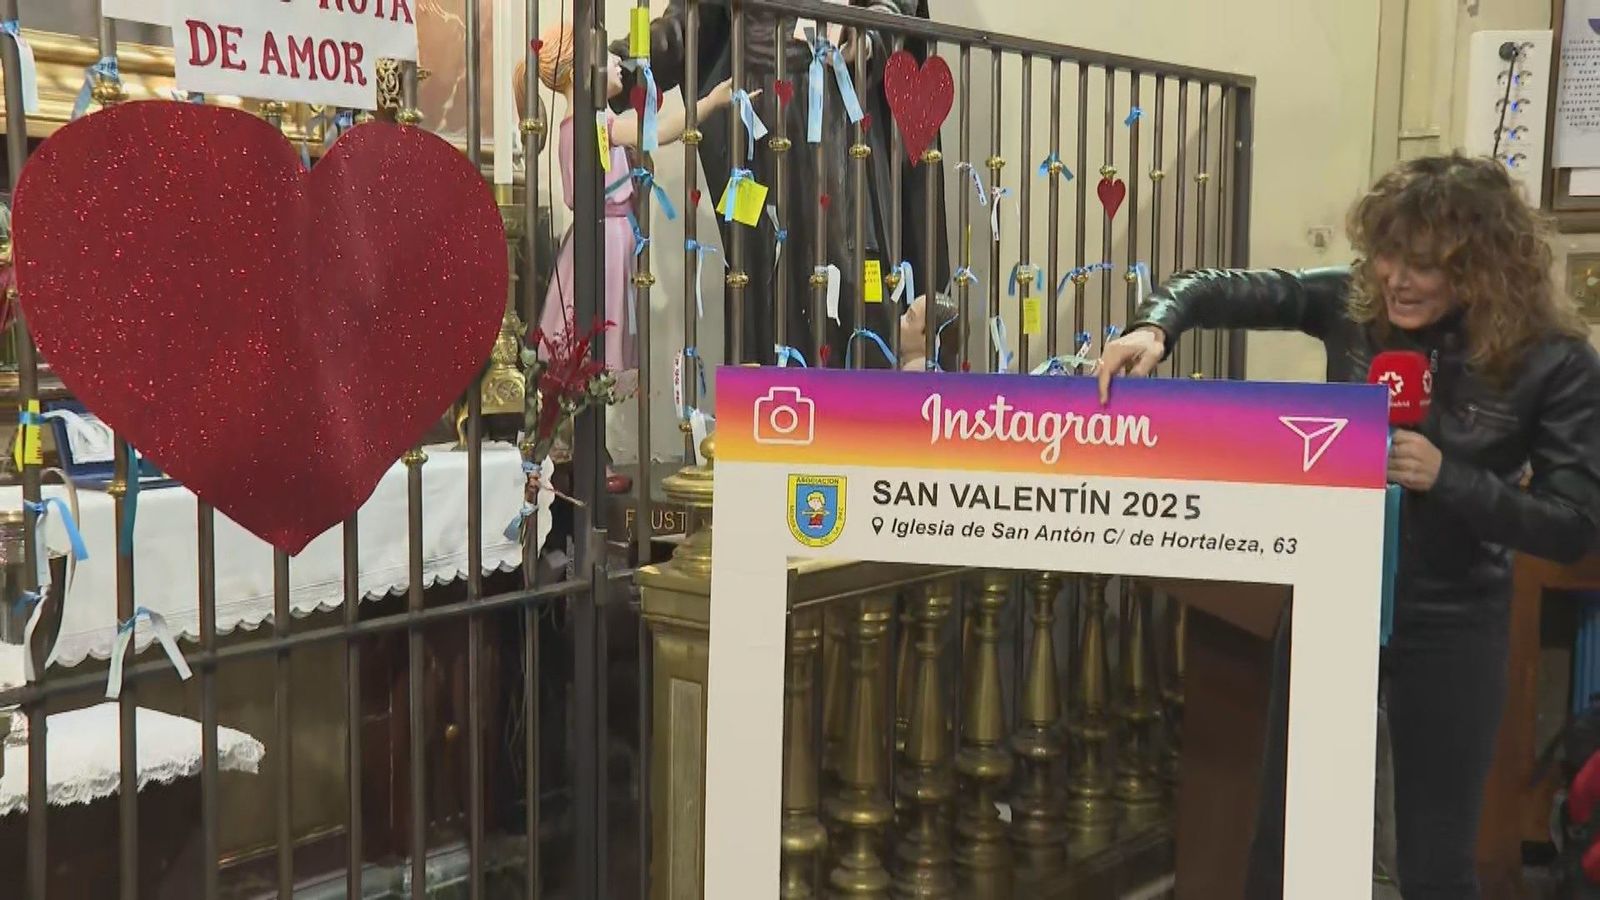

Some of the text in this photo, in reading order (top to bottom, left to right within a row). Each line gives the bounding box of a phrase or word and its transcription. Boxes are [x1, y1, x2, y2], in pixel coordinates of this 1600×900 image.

[185, 19, 367, 87] DE AMOR
[921, 393, 1158, 464] Instagram
[873, 480, 1201, 520] SAN VALENTÍN 2025
[891, 518, 1298, 555] Iglesia de San Antón C/ de Hortaleza, 63
